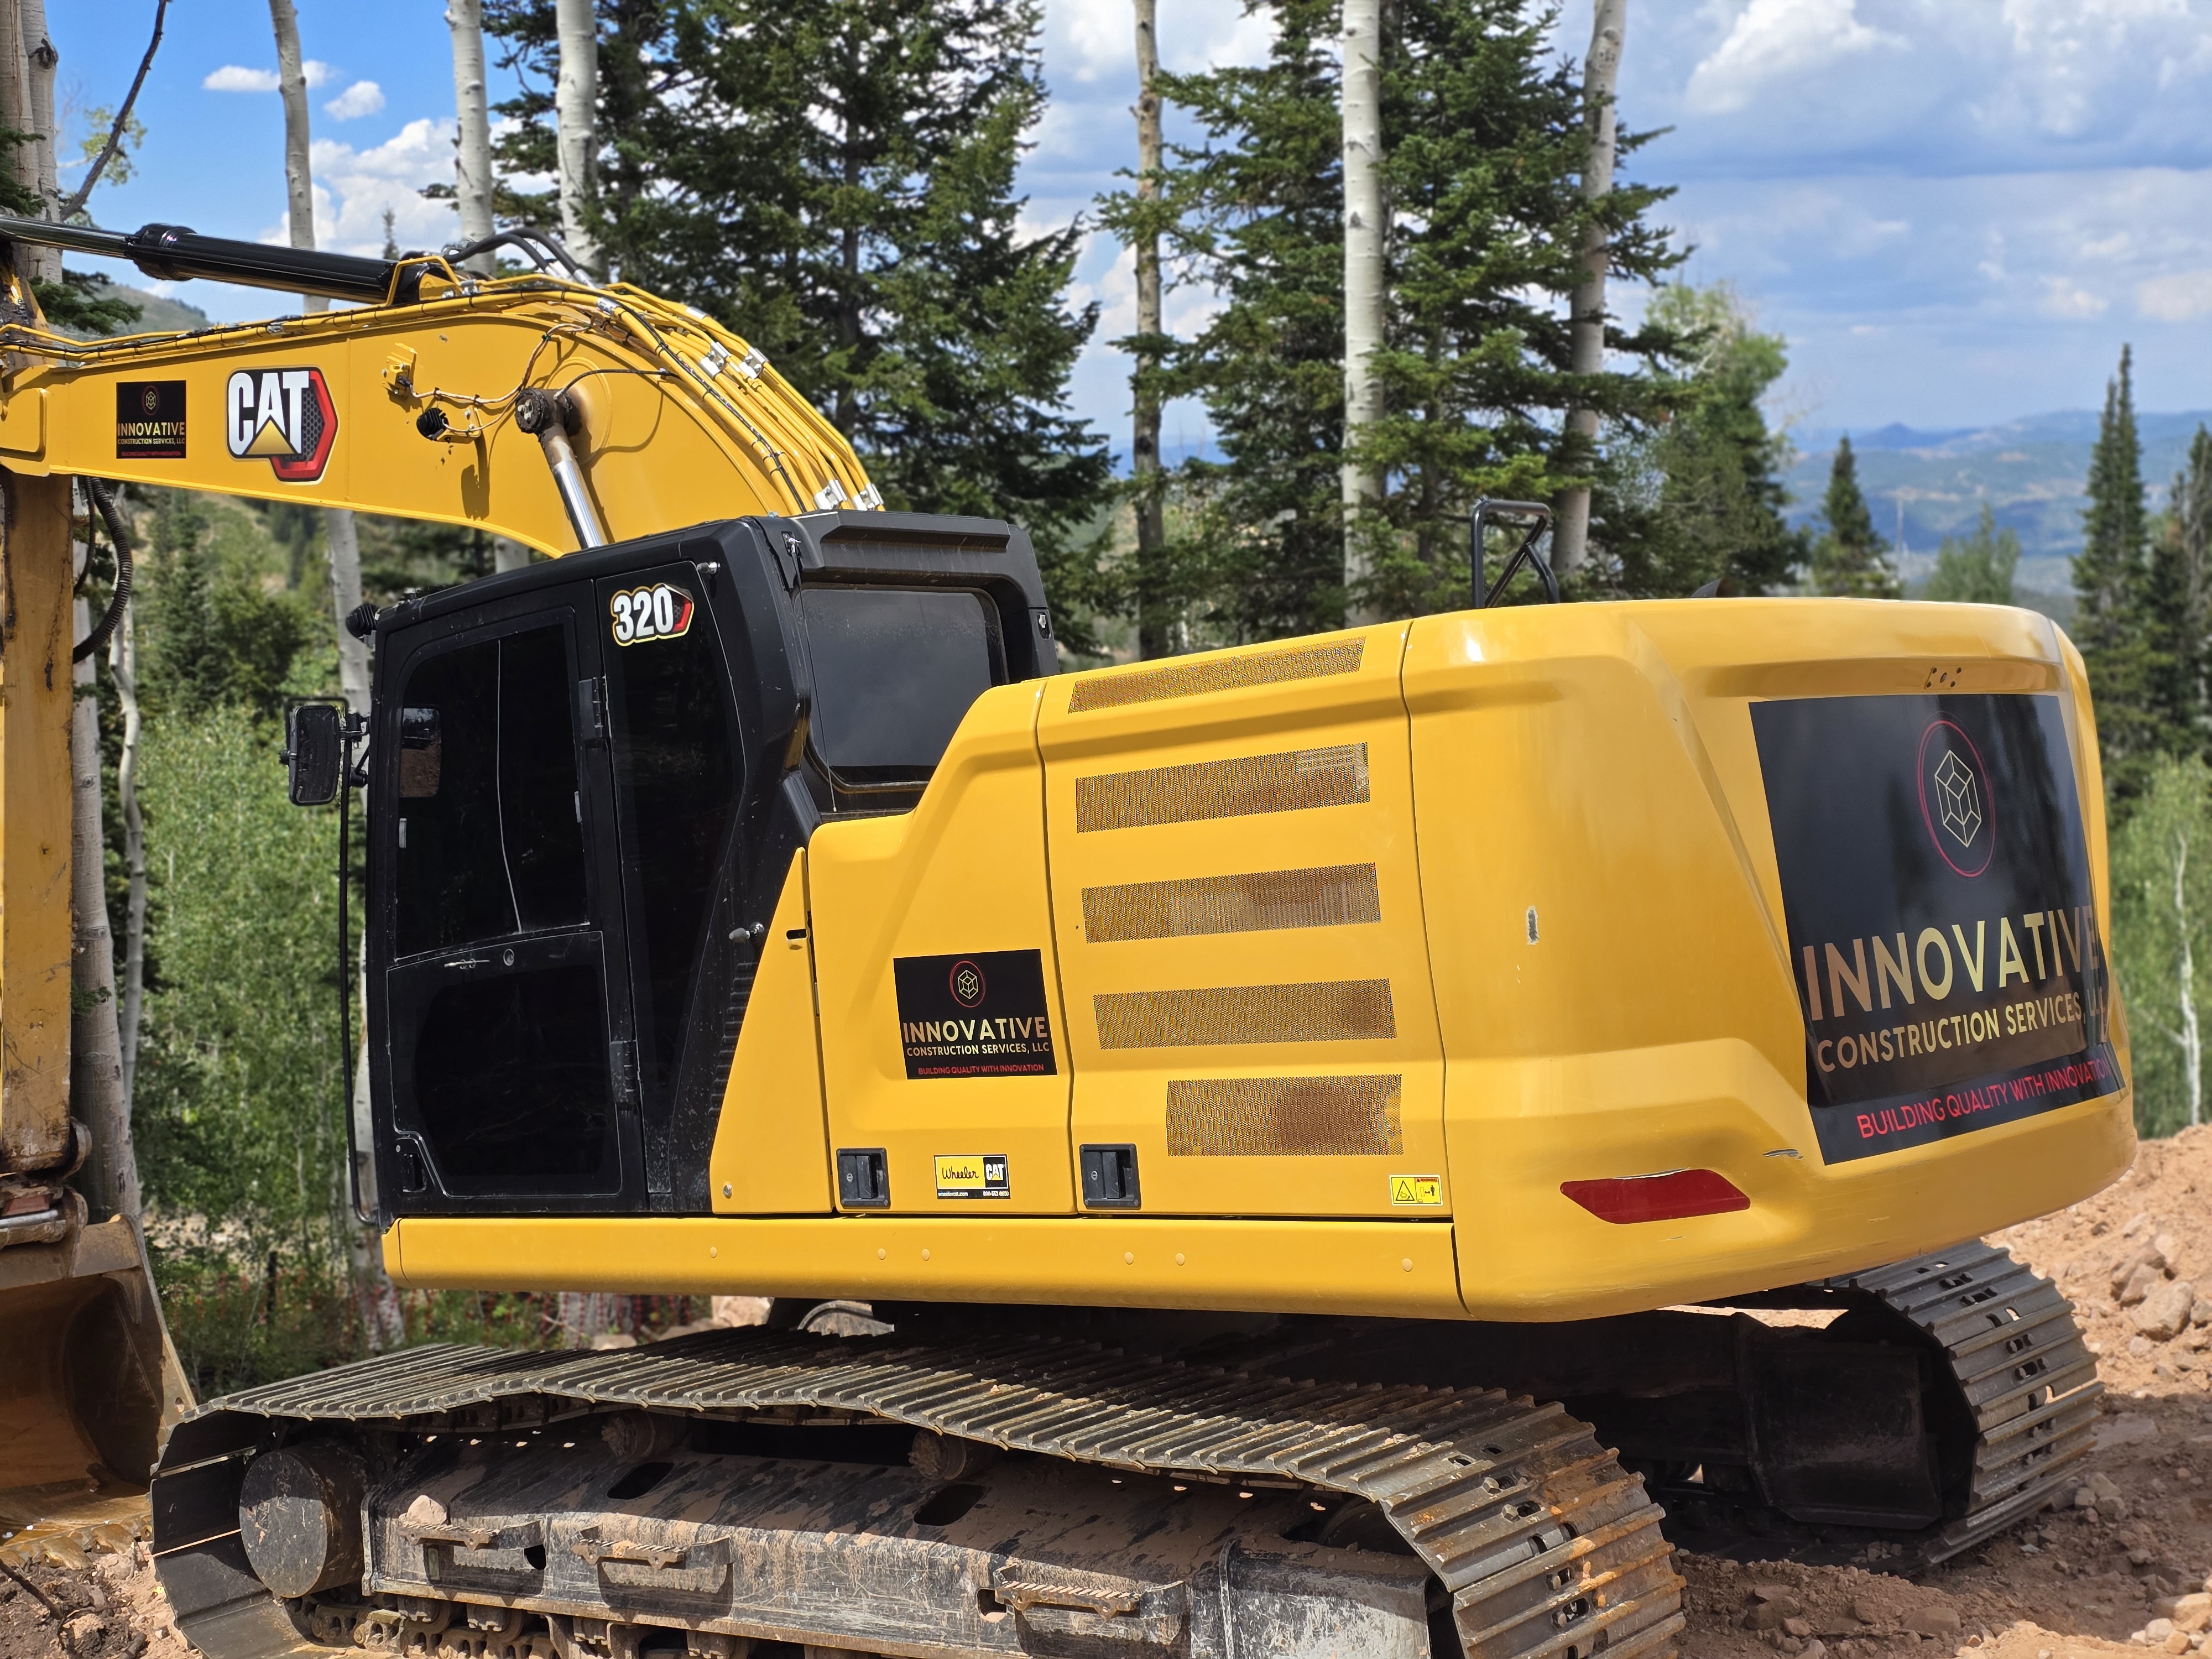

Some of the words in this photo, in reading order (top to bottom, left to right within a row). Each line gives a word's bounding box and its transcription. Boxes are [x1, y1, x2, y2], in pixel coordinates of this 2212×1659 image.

[228, 371, 309, 455] CAT
[118, 422, 185, 436] INNOVATIVE
[613, 587, 674, 640] 320
[1803, 905, 2100, 1021] INNOVATIVE
[903, 1016, 1047, 1043] INNOVATIVE
[1818, 1008, 2000, 1072] CONSTRUCTION
[2005, 992, 2086, 1036] SERVICES,
[907, 1045, 979, 1057] CONSTRUCTION
[982, 1044, 1030, 1055] SERVICES,
[1032, 1042, 1050, 1052] LLC
[918, 1066, 951, 1075] BUILDING
[951, 1065, 980, 1074] QUALITY
[1000, 1064, 1044, 1072] INNOVATION
[1856, 1098, 1945, 1139] BUILDING
[1946, 1082, 2008, 1118] QUALITY
[2008, 1073, 2046, 1102] WITH
[2045, 1057, 2112, 1093] INNOVATION
[942, 1166, 979, 1179] Wheeler
[985, 1164, 1005, 1181] CAT
